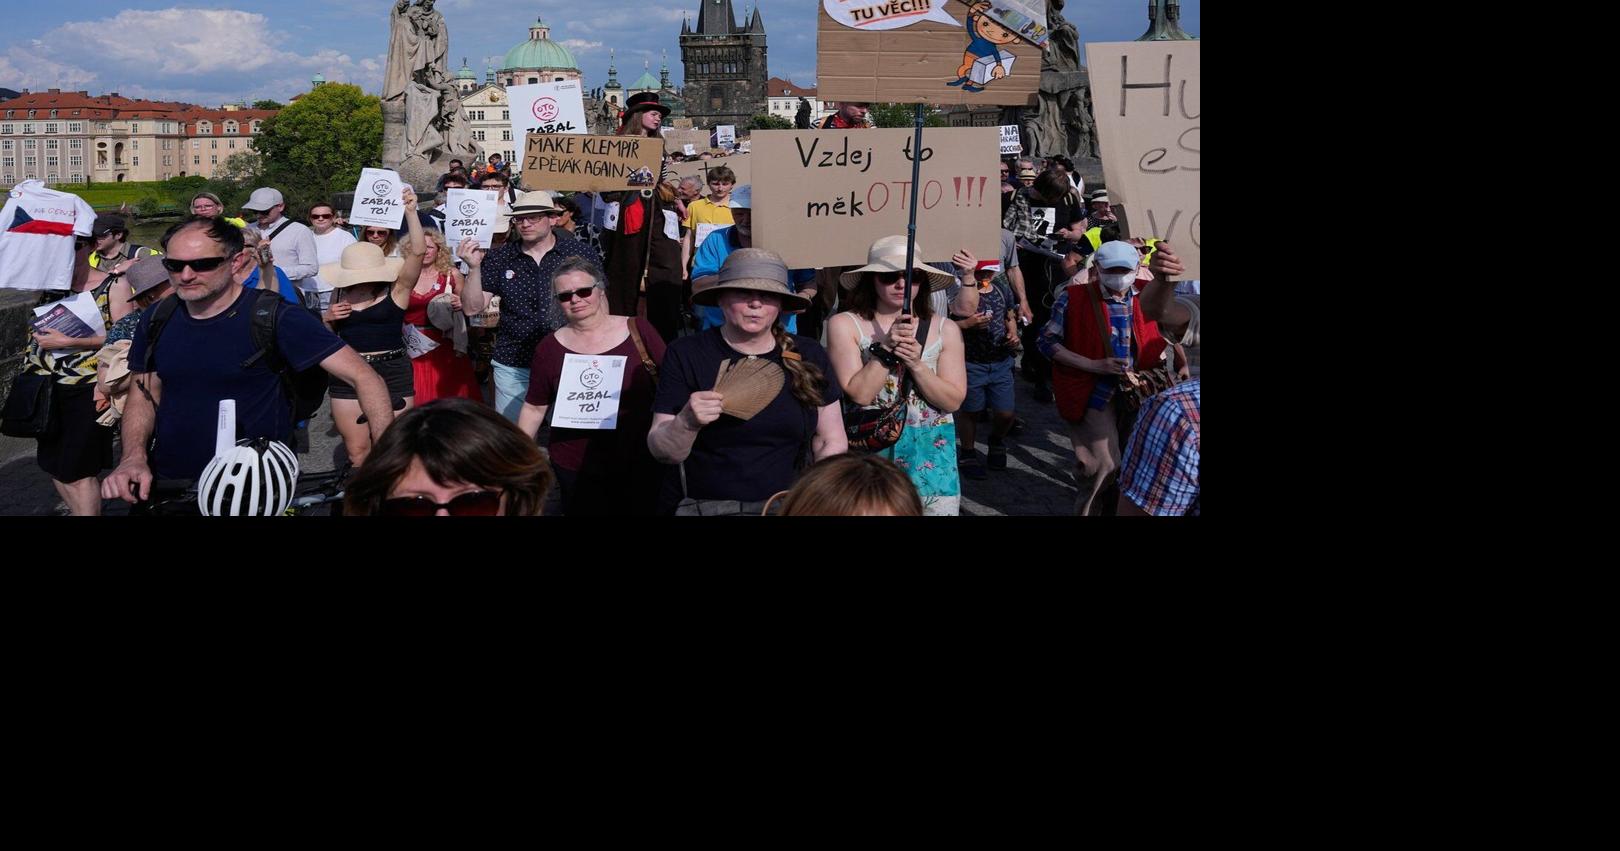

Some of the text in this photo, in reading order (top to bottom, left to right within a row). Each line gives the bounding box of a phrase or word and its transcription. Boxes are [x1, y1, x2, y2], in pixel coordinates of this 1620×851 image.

[850, 7, 873, 21] TU
[537, 104, 554, 112] OTO
[528, 137, 640, 160] MAKE KLEMPÍŘ
[795, 136, 934, 172] Vzdej to
[528, 154, 625, 178] ZPĚVÁK AGAIN
[361, 198, 399, 206] ZABAL
[371, 207, 389, 215] TO!
[451, 219, 488, 227] ZABAL
[460, 227, 478, 236] TO!
[567, 391, 611, 400] ZABAL
[579, 401, 600, 412] TO!
